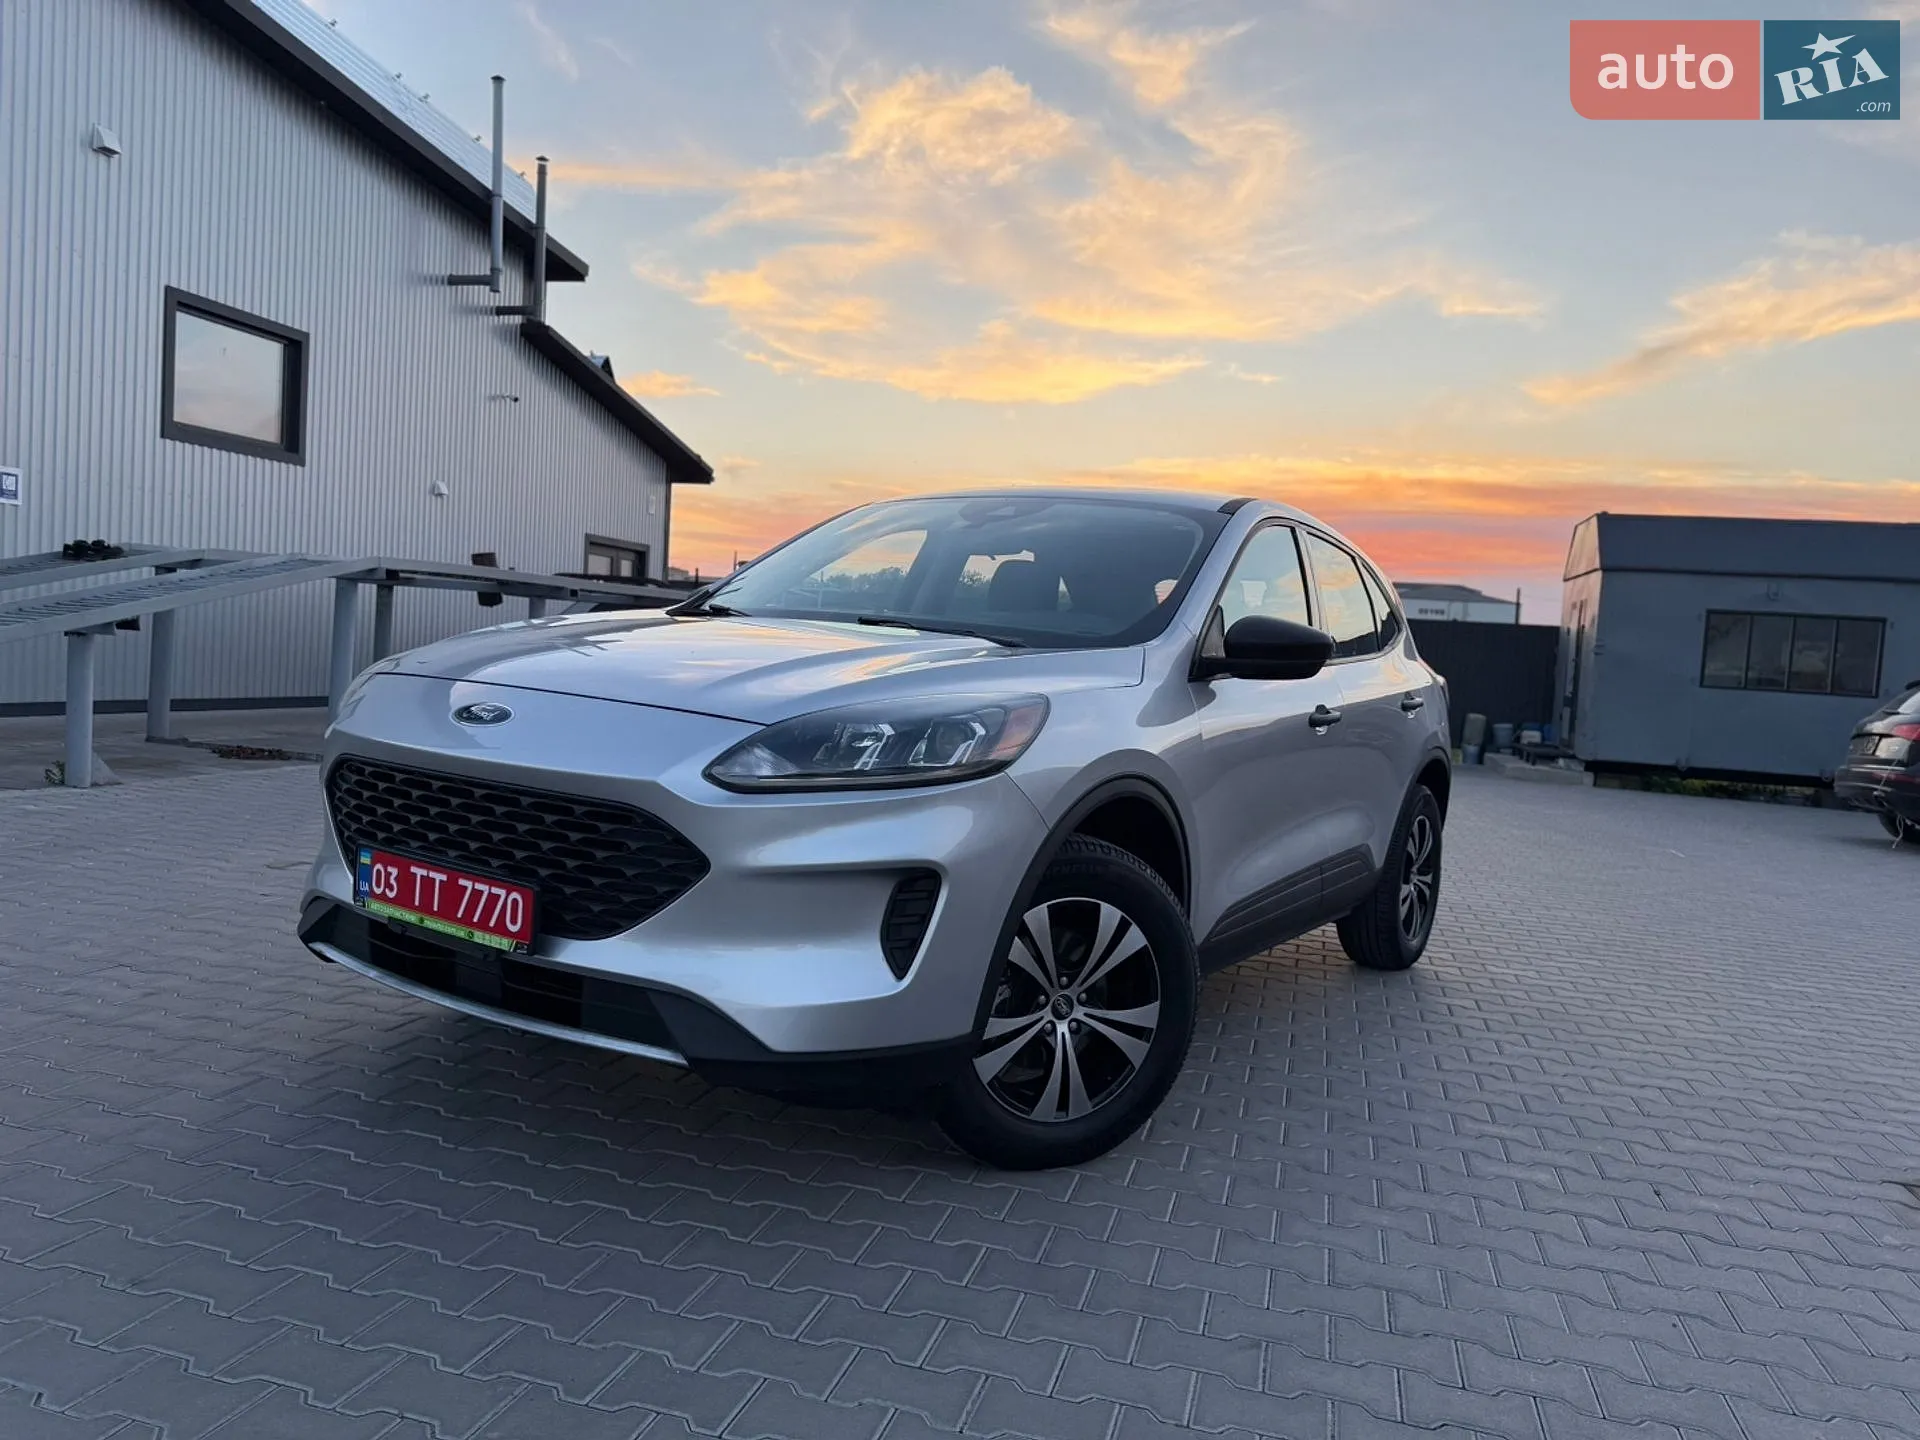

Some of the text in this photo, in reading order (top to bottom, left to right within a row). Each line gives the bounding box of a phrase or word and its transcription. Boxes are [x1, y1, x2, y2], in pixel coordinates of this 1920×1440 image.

[360, 880, 369, 891] UA
[372, 863, 398, 898] 03
[410, 866, 447, 912] TT
[457, 878, 523, 933] 7770
